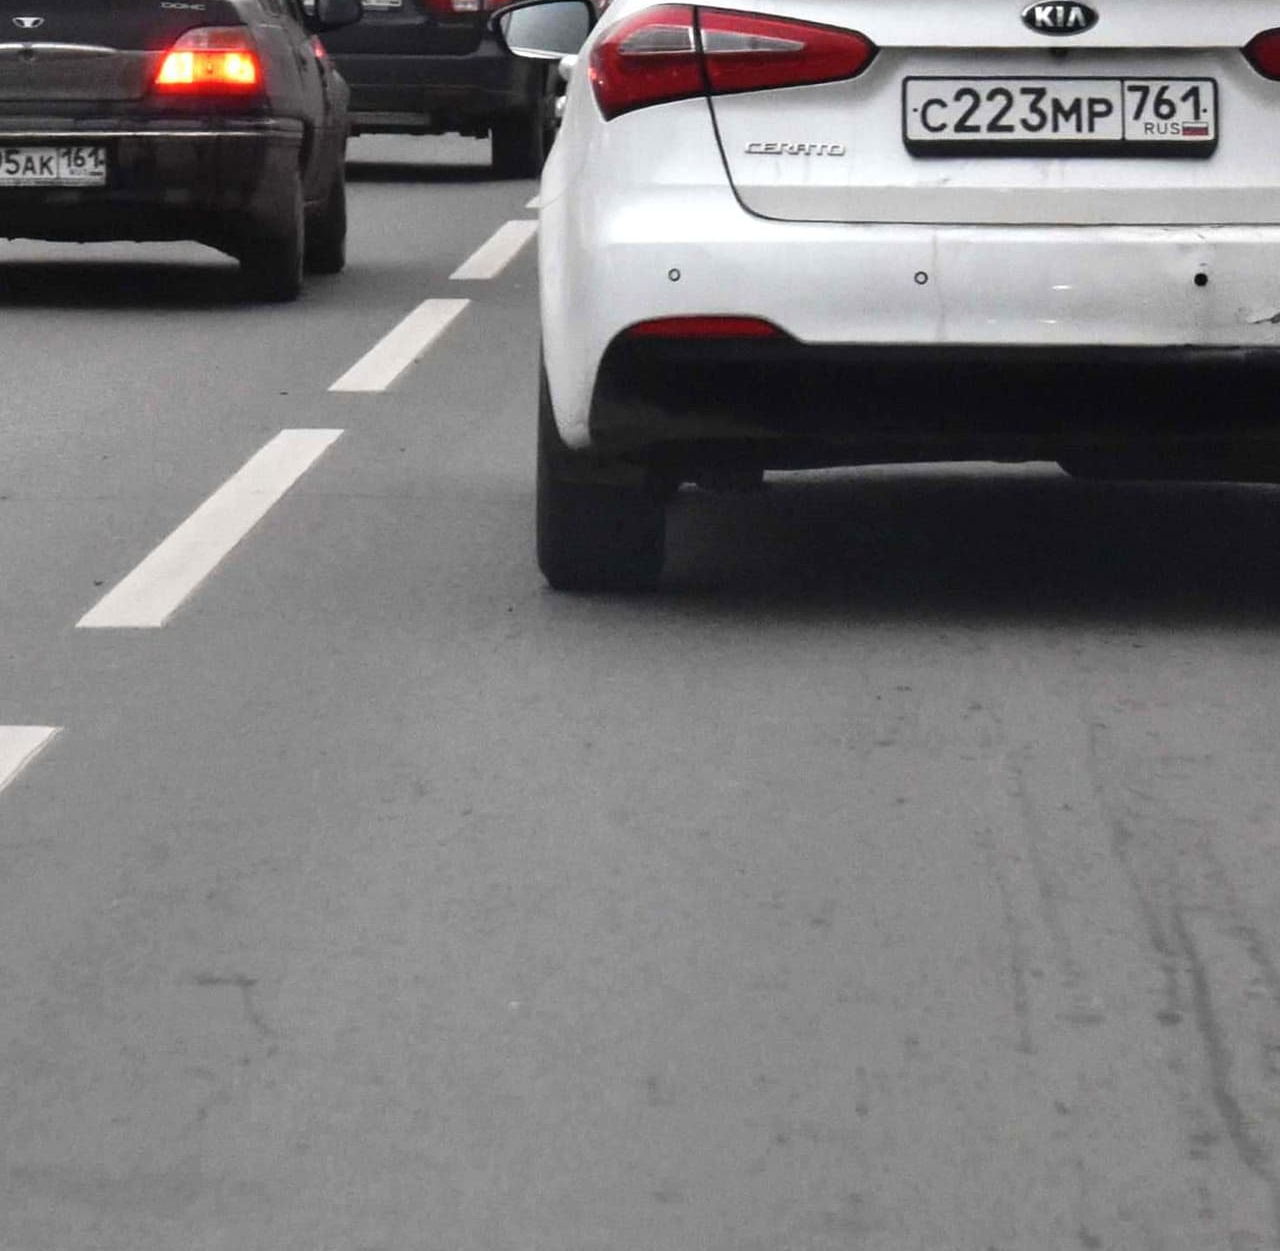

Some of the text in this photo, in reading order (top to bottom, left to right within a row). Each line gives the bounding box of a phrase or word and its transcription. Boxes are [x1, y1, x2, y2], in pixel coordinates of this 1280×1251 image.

[1034, 5, 1086, 28] KIA
[920, 84, 1201, 134] С223МР 761
[1144, 121, 1181, 136] RUS
[61, 148, 100, 168] 161
[744, 141, 847, 156] CERATO
